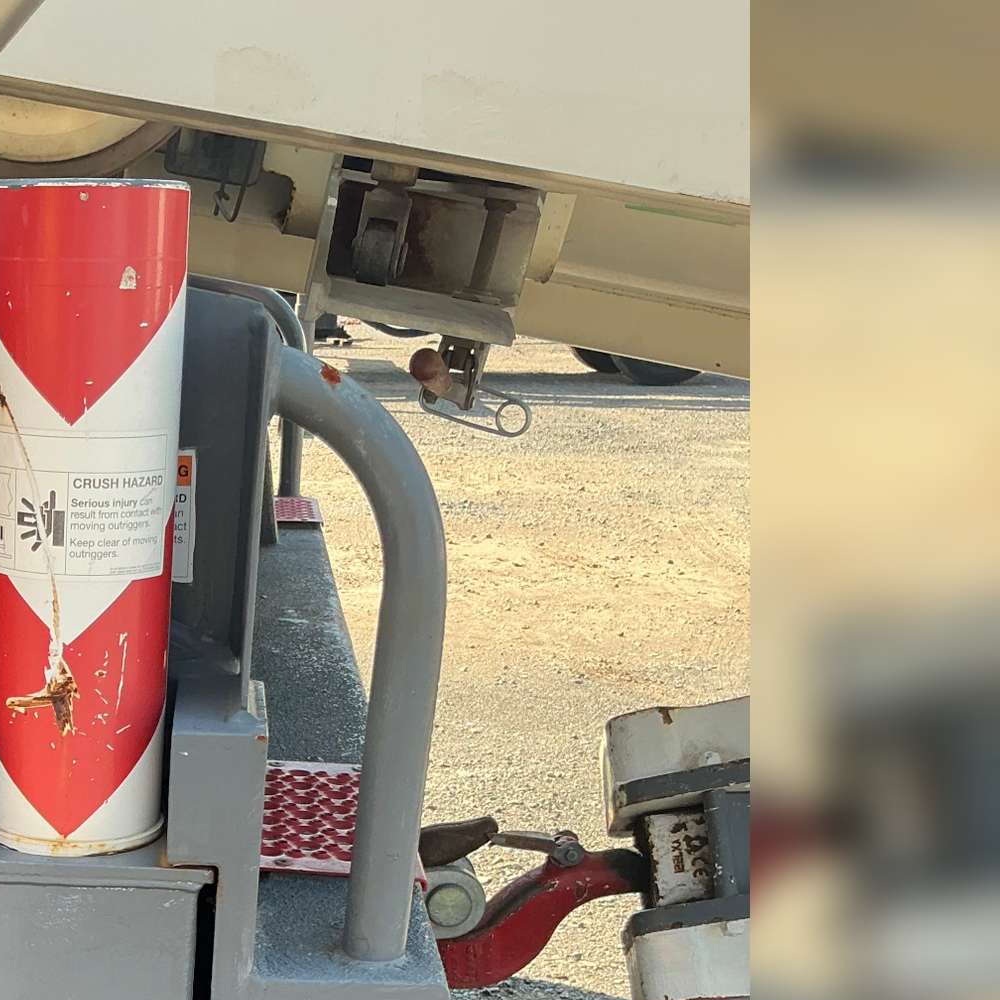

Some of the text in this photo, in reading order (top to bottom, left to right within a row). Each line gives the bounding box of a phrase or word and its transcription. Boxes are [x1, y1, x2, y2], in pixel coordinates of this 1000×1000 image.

[73, 475, 163, 489] CRUSH HAZARD
[70, 498, 153, 510] Serious injury can
[70, 510, 96, 519] result
[98, 510, 119, 519] from
[120, 508, 149, 518] contact
[70, 520, 150, 532] moving outriggers.
[69, 535, 158, 549] Keep clear of moving
[69, 550, 119, 560] outriggers.
